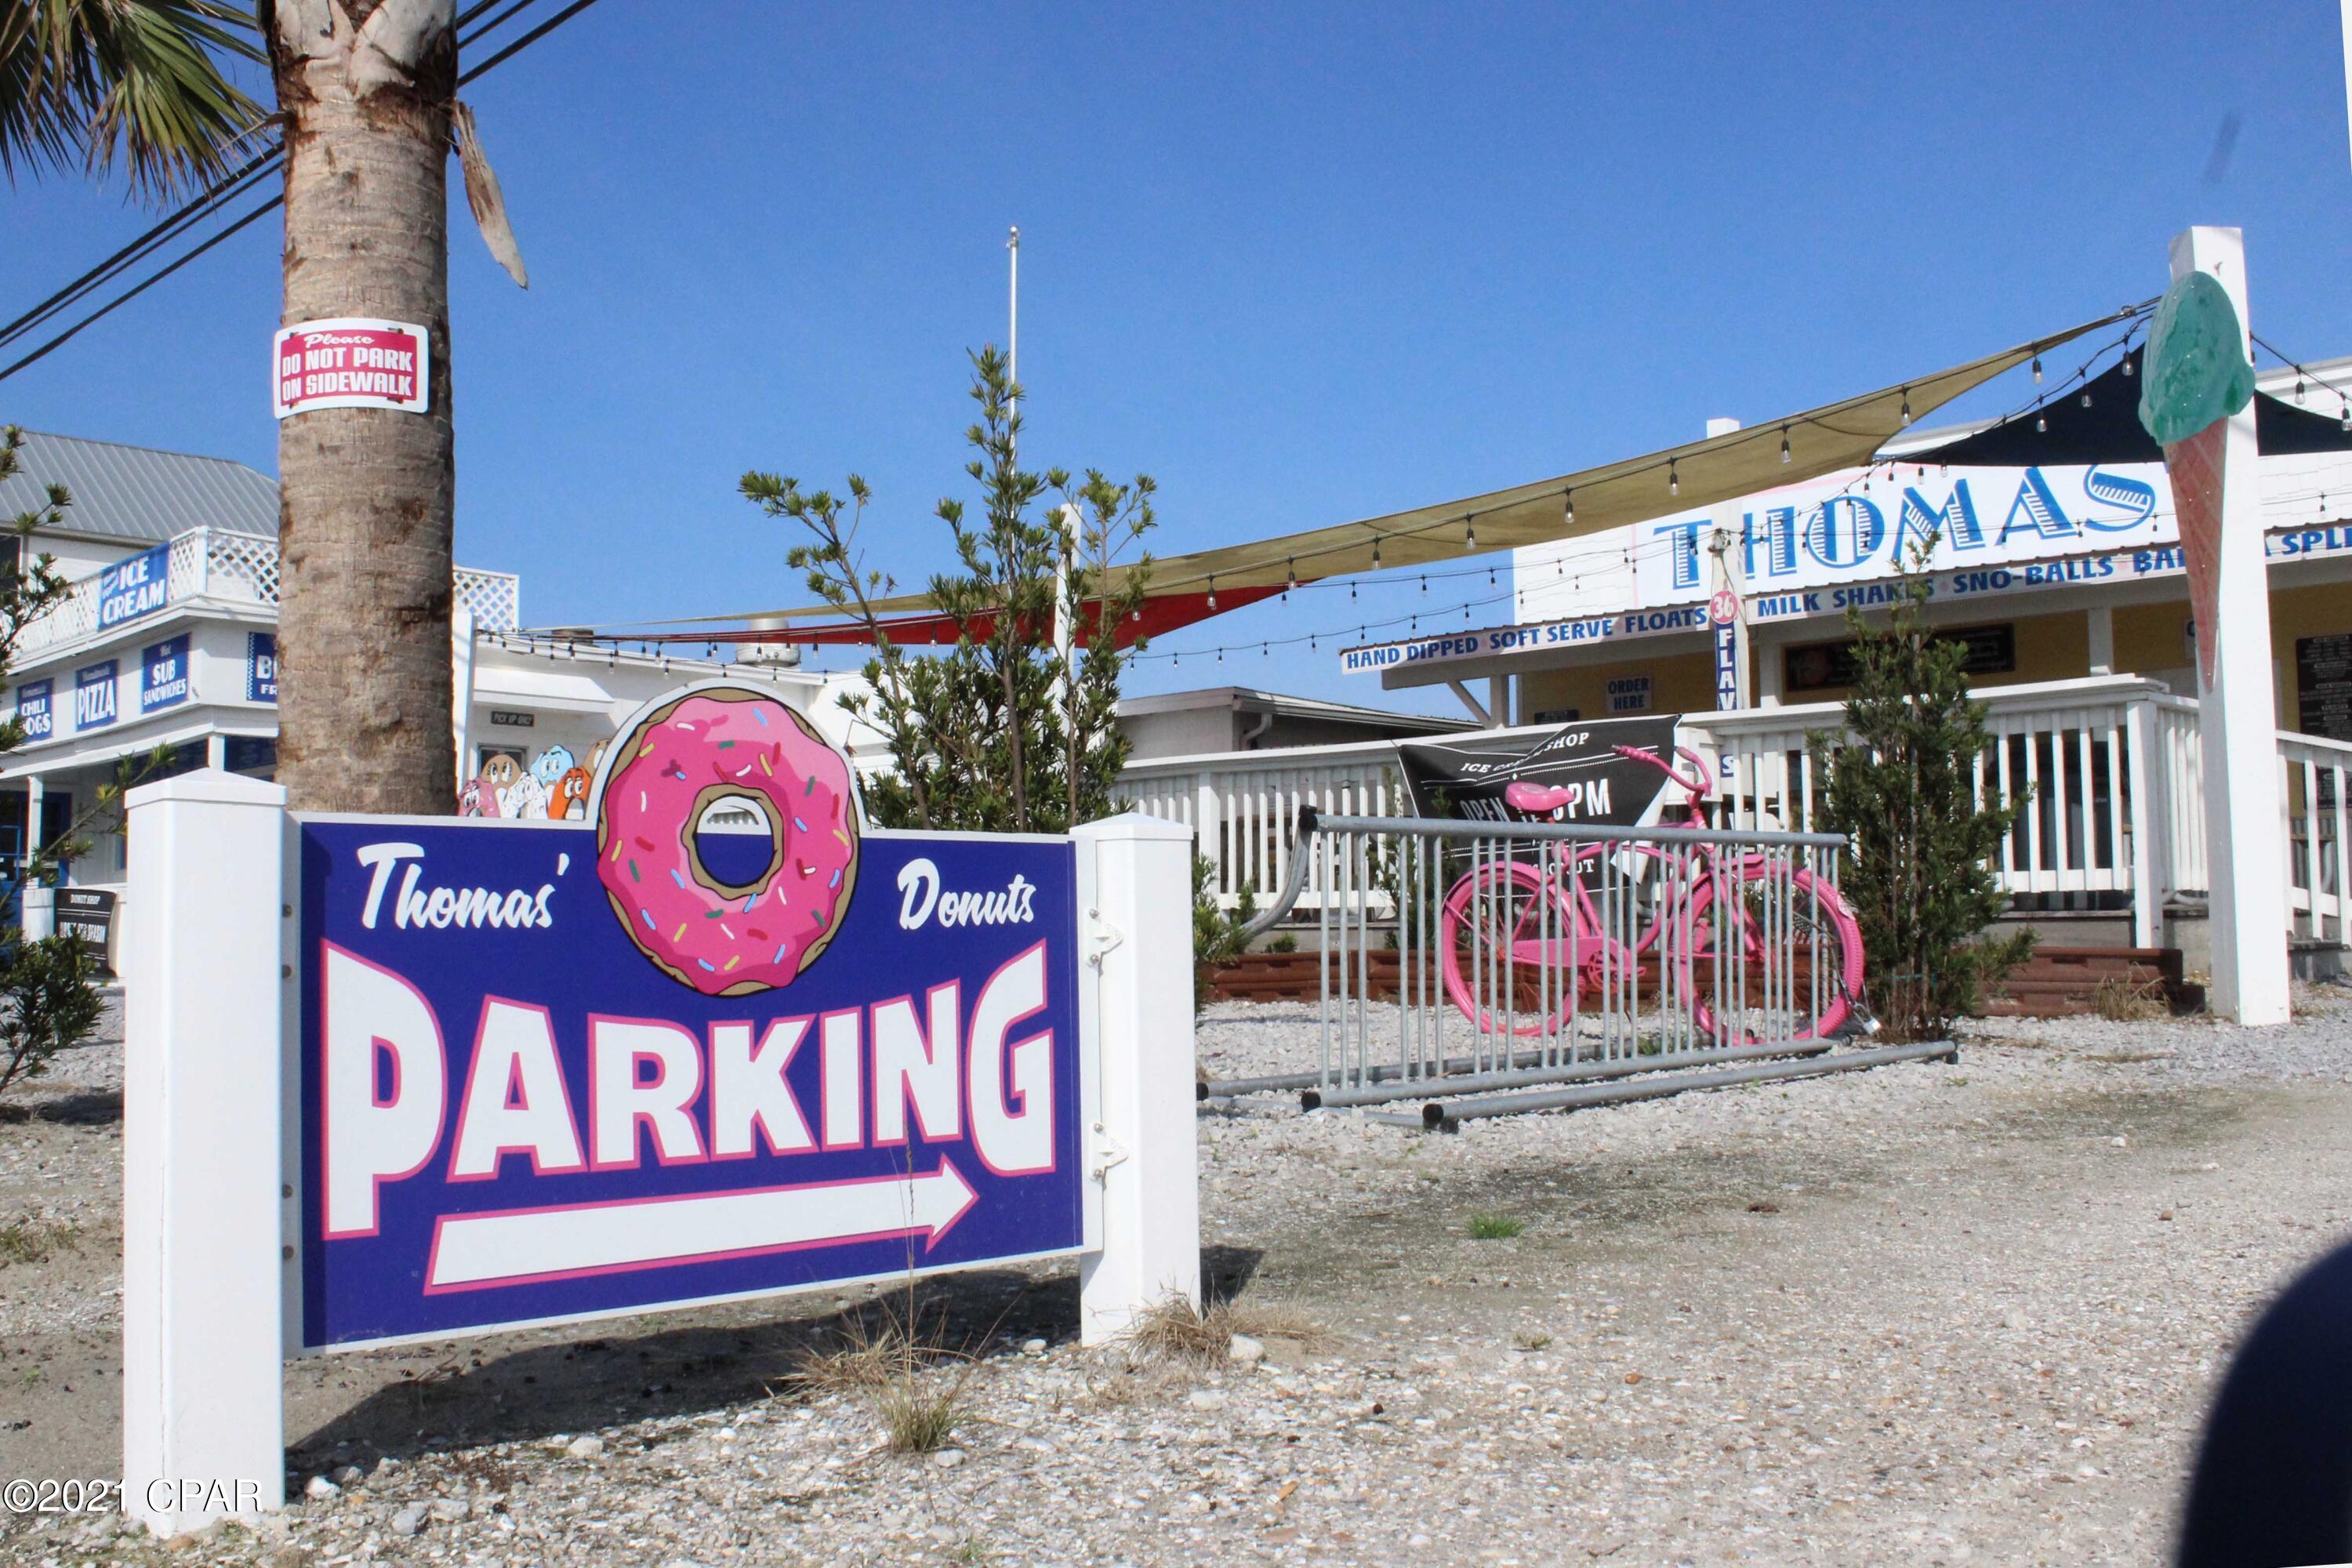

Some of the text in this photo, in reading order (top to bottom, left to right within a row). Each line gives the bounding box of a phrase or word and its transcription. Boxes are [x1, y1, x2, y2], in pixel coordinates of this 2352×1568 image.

[304, 333, 375, 348] Please
[282, 347, 413, 377] DO NOT PARK
[282, 371, 412, 401] ON SIDEWALK
[1653, 464, 2156, 590] THOMAS
[119, 556, 149, 590] ICE
[103, 579, 165, 625] CREAM
[1347, 648, 1400, 669] HAND
[1406, 637, 1479, 661] DIPPED
[1490, 628, 1541, 649] SOFT
[1547, 619, 1613, 642] SERVE
[1625, 608, 1708, 633] FLOATS
[1758, 593, 1821, 617] MILK
[1953, 555, 2114, 593] SNO-BALLS
[1714, 594, 1734, 619] 36
[152, 659, 176, 686] SUB
[1608, 677, 1650, 694] ORDER
[78, 680, 115, 725] PIZZA
[143, 678, 187, 706] SANDWICHES
[1613, 695, 1644, 710] HERE
[21, 699, 45, 717] CHILI
[23, 713, 51, 735] OGS
[1460, 762, 1492, 774] ICE
[357, 841, 1038, 930] Thomas' Donuts
[321, 938, 1056, 1240] PARKING
